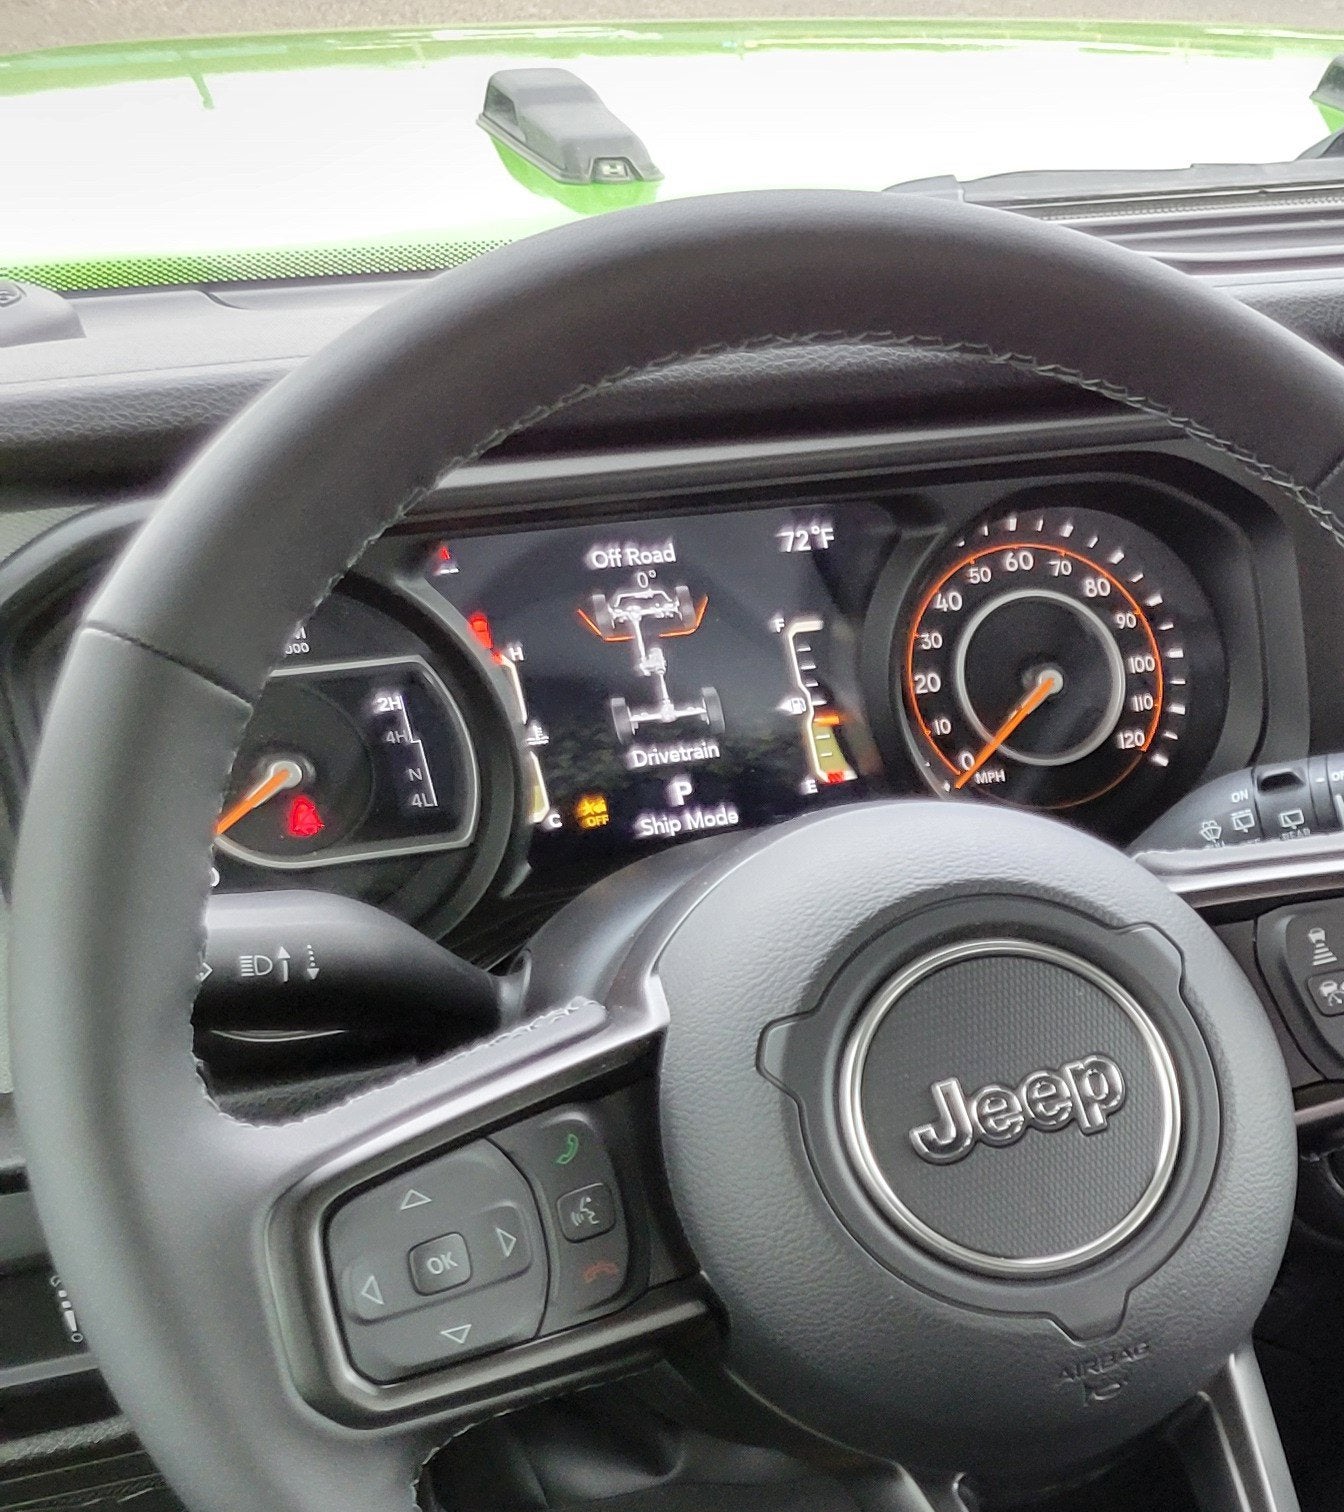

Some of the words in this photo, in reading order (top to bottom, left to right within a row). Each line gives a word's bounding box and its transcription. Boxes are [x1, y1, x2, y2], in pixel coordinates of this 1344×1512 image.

[592, 547, 622, 569] Off
[627, 542, 676, 567] Road
[1005, 551, 1034, 572] 60
[968, 567, 992, 585] 50
[1049, 560, 1072, 577] 70
[1084, 577, 1111, 598] 80
[934, 591, 963, 612] 40
[774, 618, 785, 633] F
[1115, 613, 1137, 630] 90
[921, 631, 943, 650] 30
[509, 645, 524, 662] H
[1129, 656, 1156, 674] 100
[913, 672, 941, 695] 20
[377, 695, 402, 712] 2H
[1131, 692, 1154, 712] 110
[932, 718, 951, 736] 10
[385, 730, 408, 745] 4H
[1117, 731, 1146, 750] 120
[632, 743, 721, 768] Drivetrain
[957, 750, 976, 771] 0
[408, 767, 423, 782] N
[975, 769, 1006, 785] MPH
[676, 781, 693, 806] P
[805, 779, 818, 794] E
[411, 793, 434, 808] 4L
[1231, 789, 1249, 804] ON
[549, 813, 563, 829] C
[587, 814, 610, 828] OFF
[642, 817, 682, 838] Ship
[690, 807, 739, 831] Mode
[909, 1053, 1126, 1166] Jeep
[425, 1242, 458, 1275] OK
